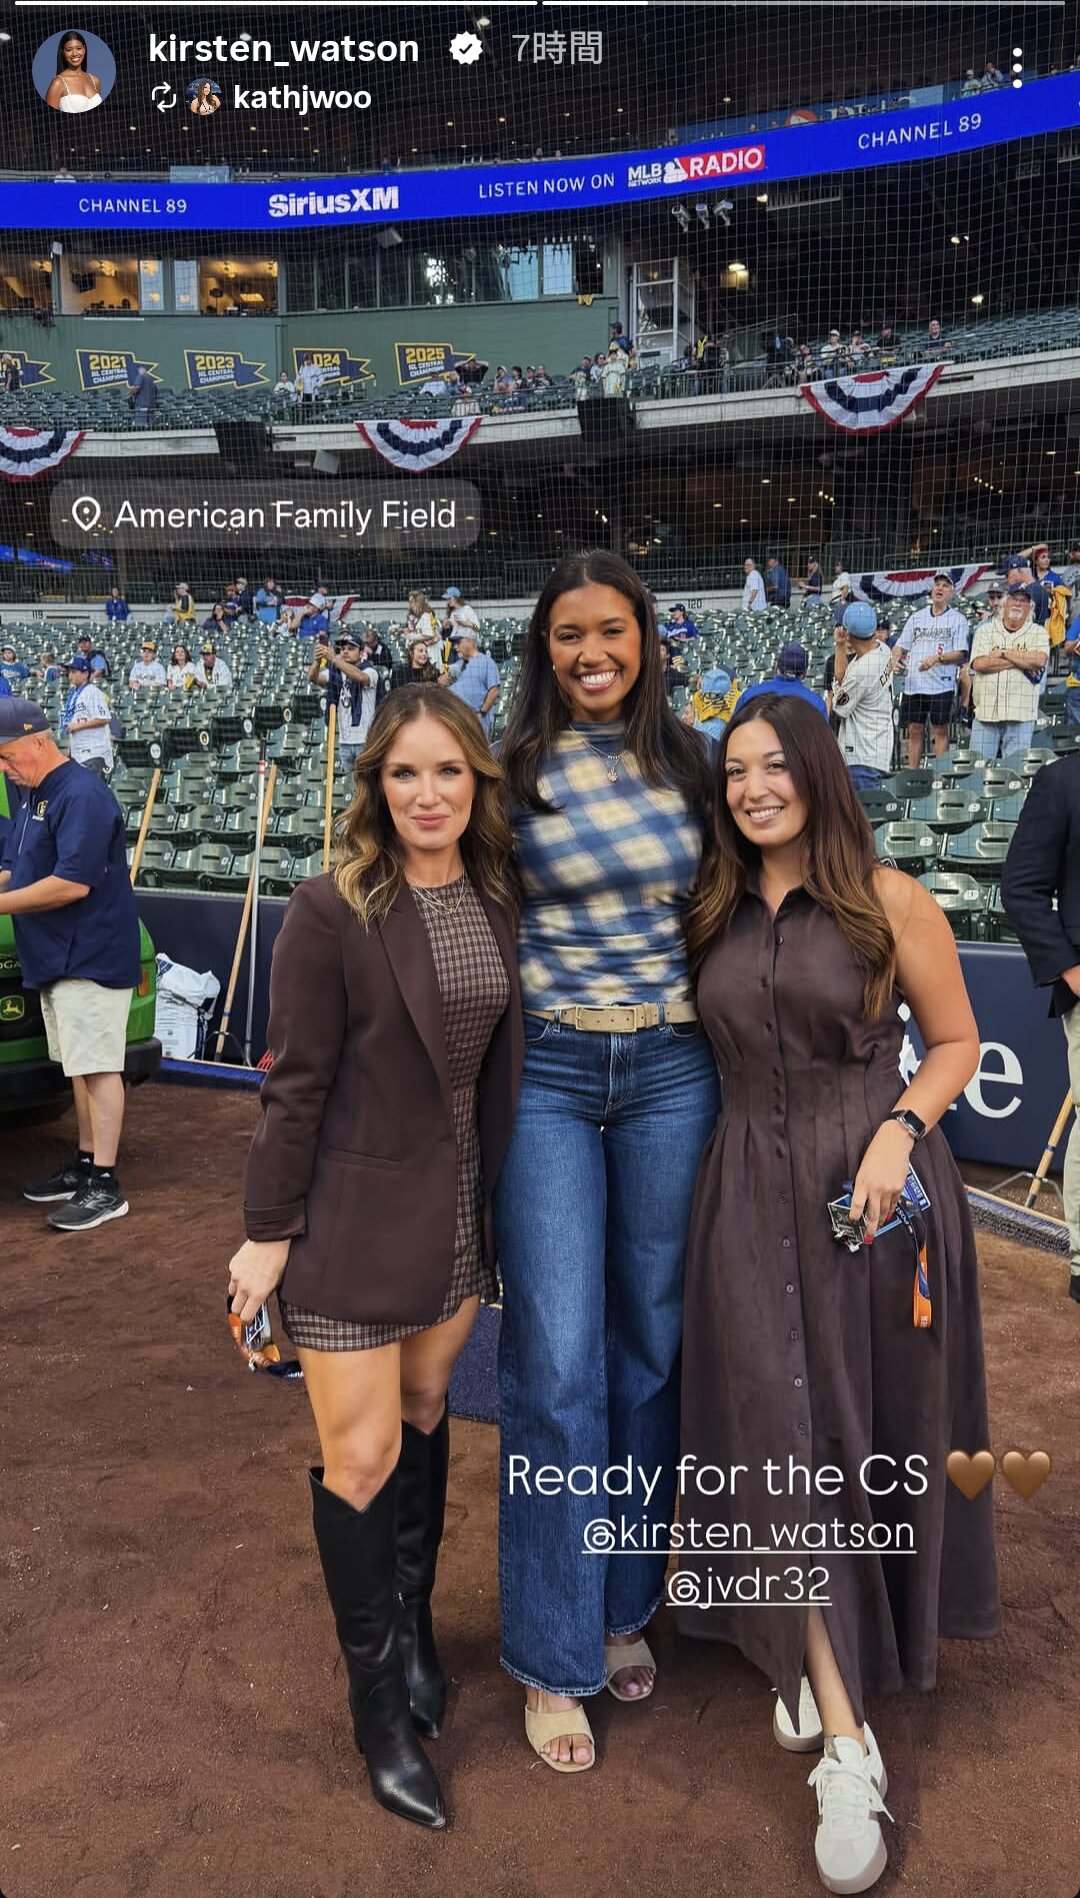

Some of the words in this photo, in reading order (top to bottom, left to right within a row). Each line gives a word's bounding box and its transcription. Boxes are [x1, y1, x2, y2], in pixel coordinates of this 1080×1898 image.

[858, 120, 952, 149] CHANNEL
[958, 113, 982, 132] 89
[689, 147, 763, 177] RADIO
[628, 162, 663, 180] MLB
[479, 180, 538, 199] LISTEN
[543, 176, 585, 194] NOW
[591, 172, 615, 189] ON
[628, 177, 662, 188] NETWORK
[79, 198, 161, 213] CHANNEL
[166, 199, 187, 213] 89
[268, 186, 399, 218] SiriusXM
[89, 354, 127, 370] 2021
[195, 355, 235, 370] 2023
[406, 347, 445, 363] 2025
[688, 598, 703, 609] 120
[32, 610, 43, 619] 119
[937, 643, 944, 656] 5
